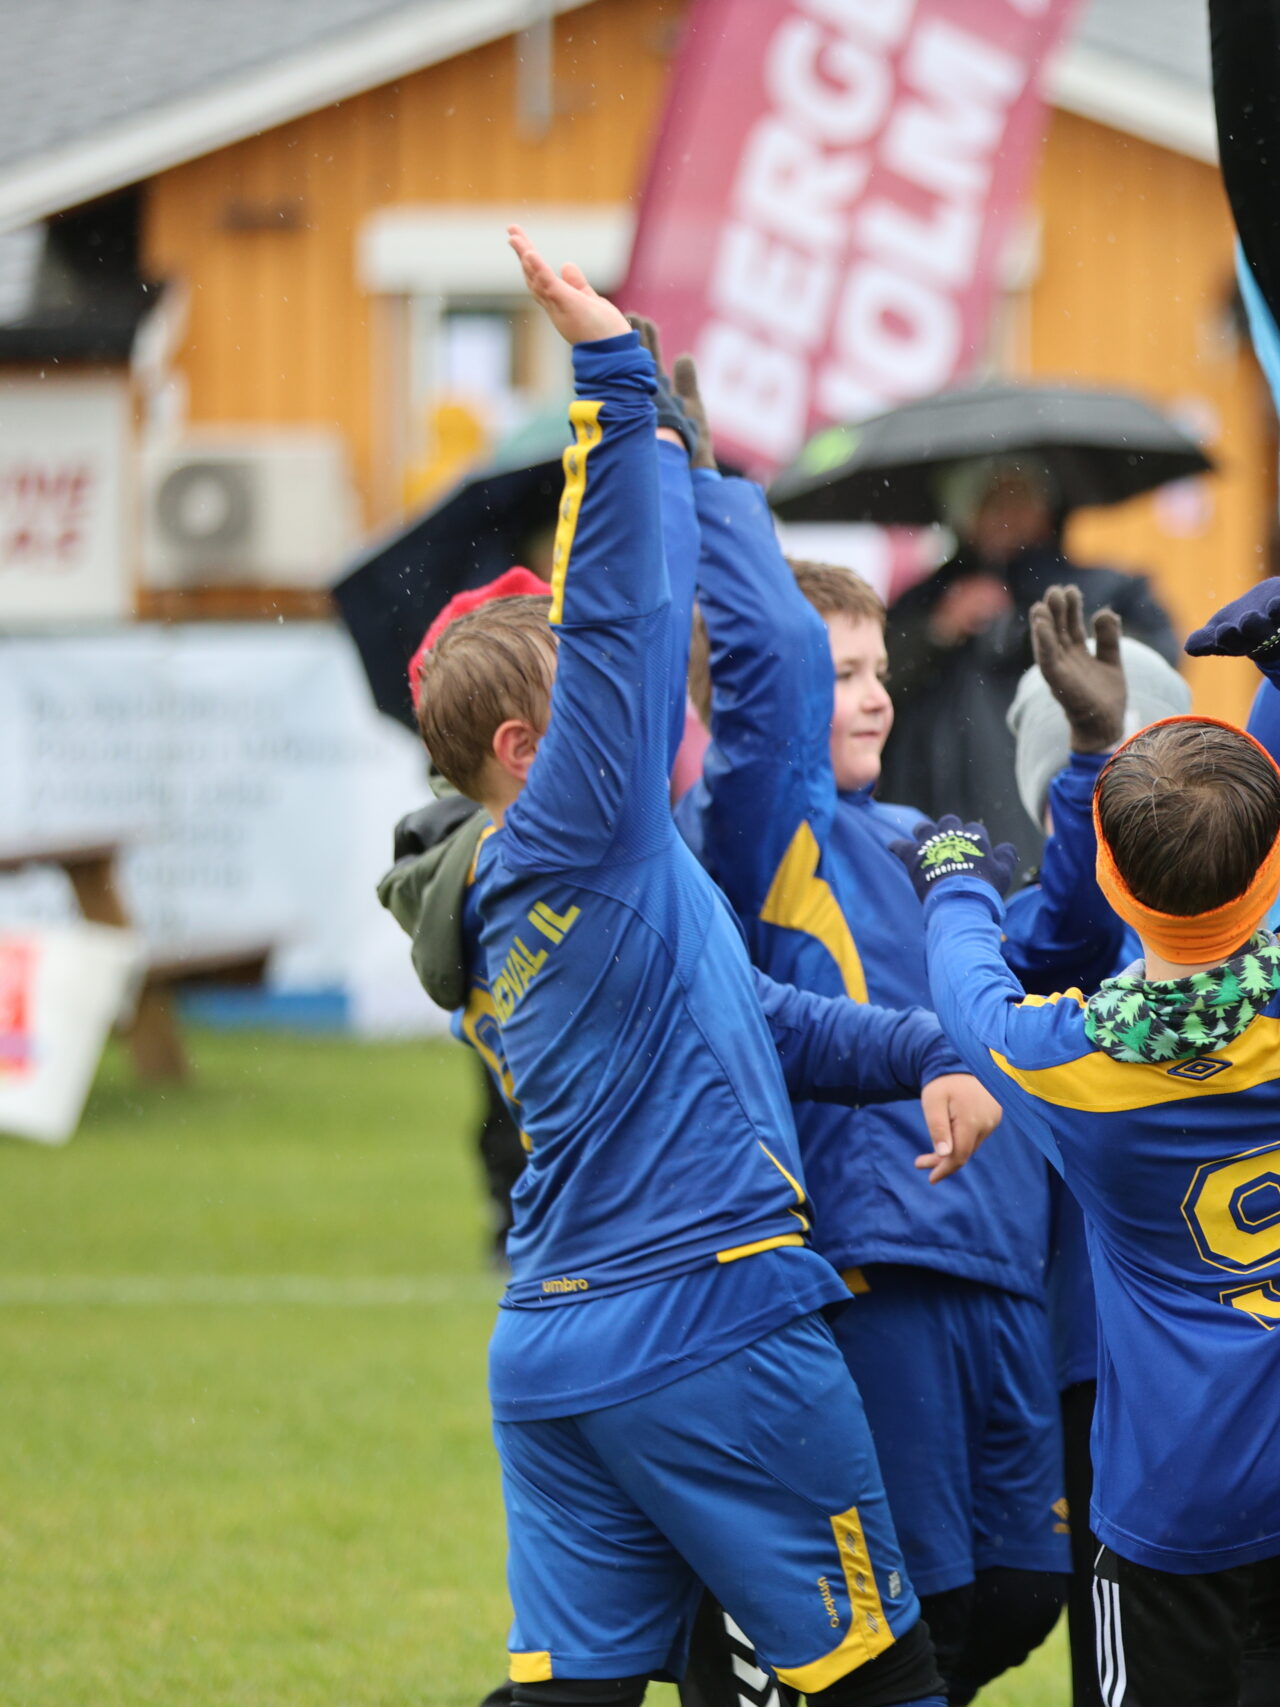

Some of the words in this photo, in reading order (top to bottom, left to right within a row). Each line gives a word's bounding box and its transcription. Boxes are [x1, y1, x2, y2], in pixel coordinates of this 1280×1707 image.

[925, 862, 974, 881] TERRITORY
[527, 901, 581, 945] IL
[542, 1276, 589, 1293] umbro
[817, 1576, 840, 1628] umbro
